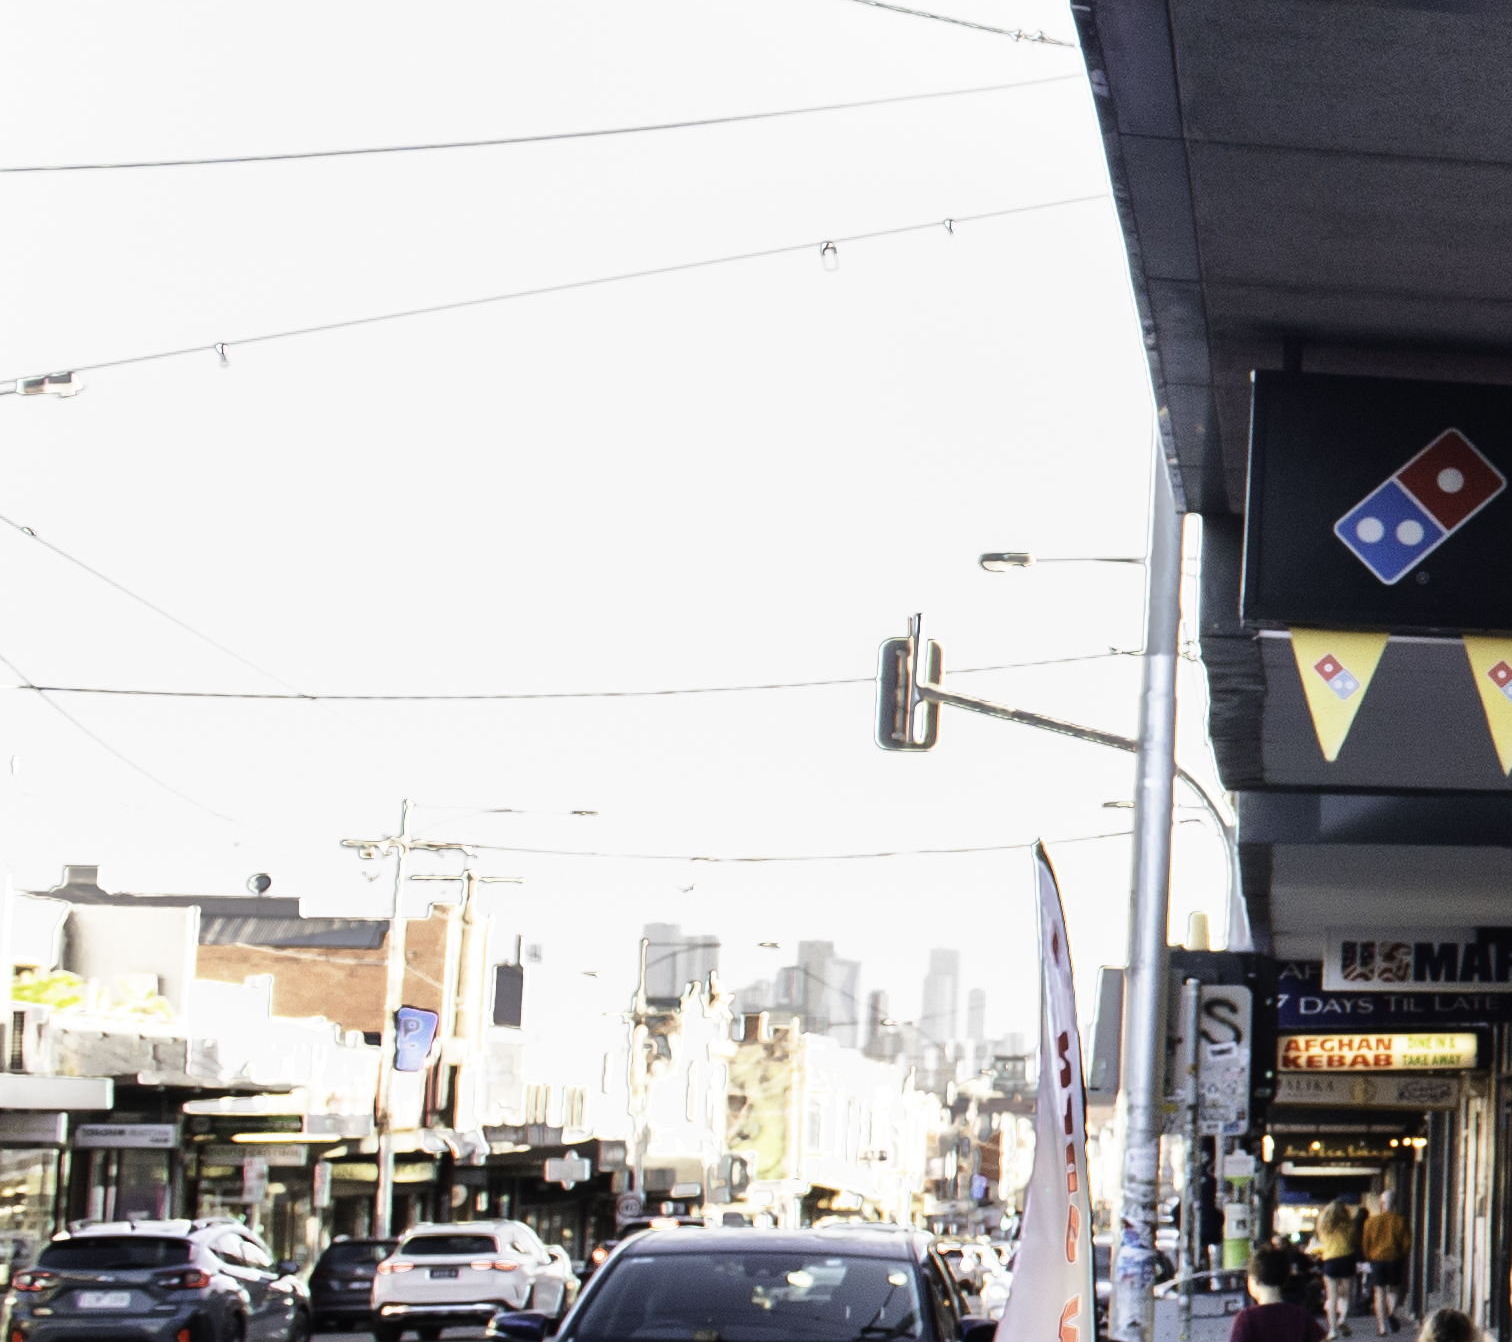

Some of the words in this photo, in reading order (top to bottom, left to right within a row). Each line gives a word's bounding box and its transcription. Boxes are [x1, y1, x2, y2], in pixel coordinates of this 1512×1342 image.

[1299, 994, 1375, 1016] DAYS
[1383, 992, 1426, 1013] TIL
[1433, 993, 1502, 1012] LATE
[1284, 1036, 1393, 1053] AFGHAN
[1282, 1053, 1393, 1069] KEBAB
